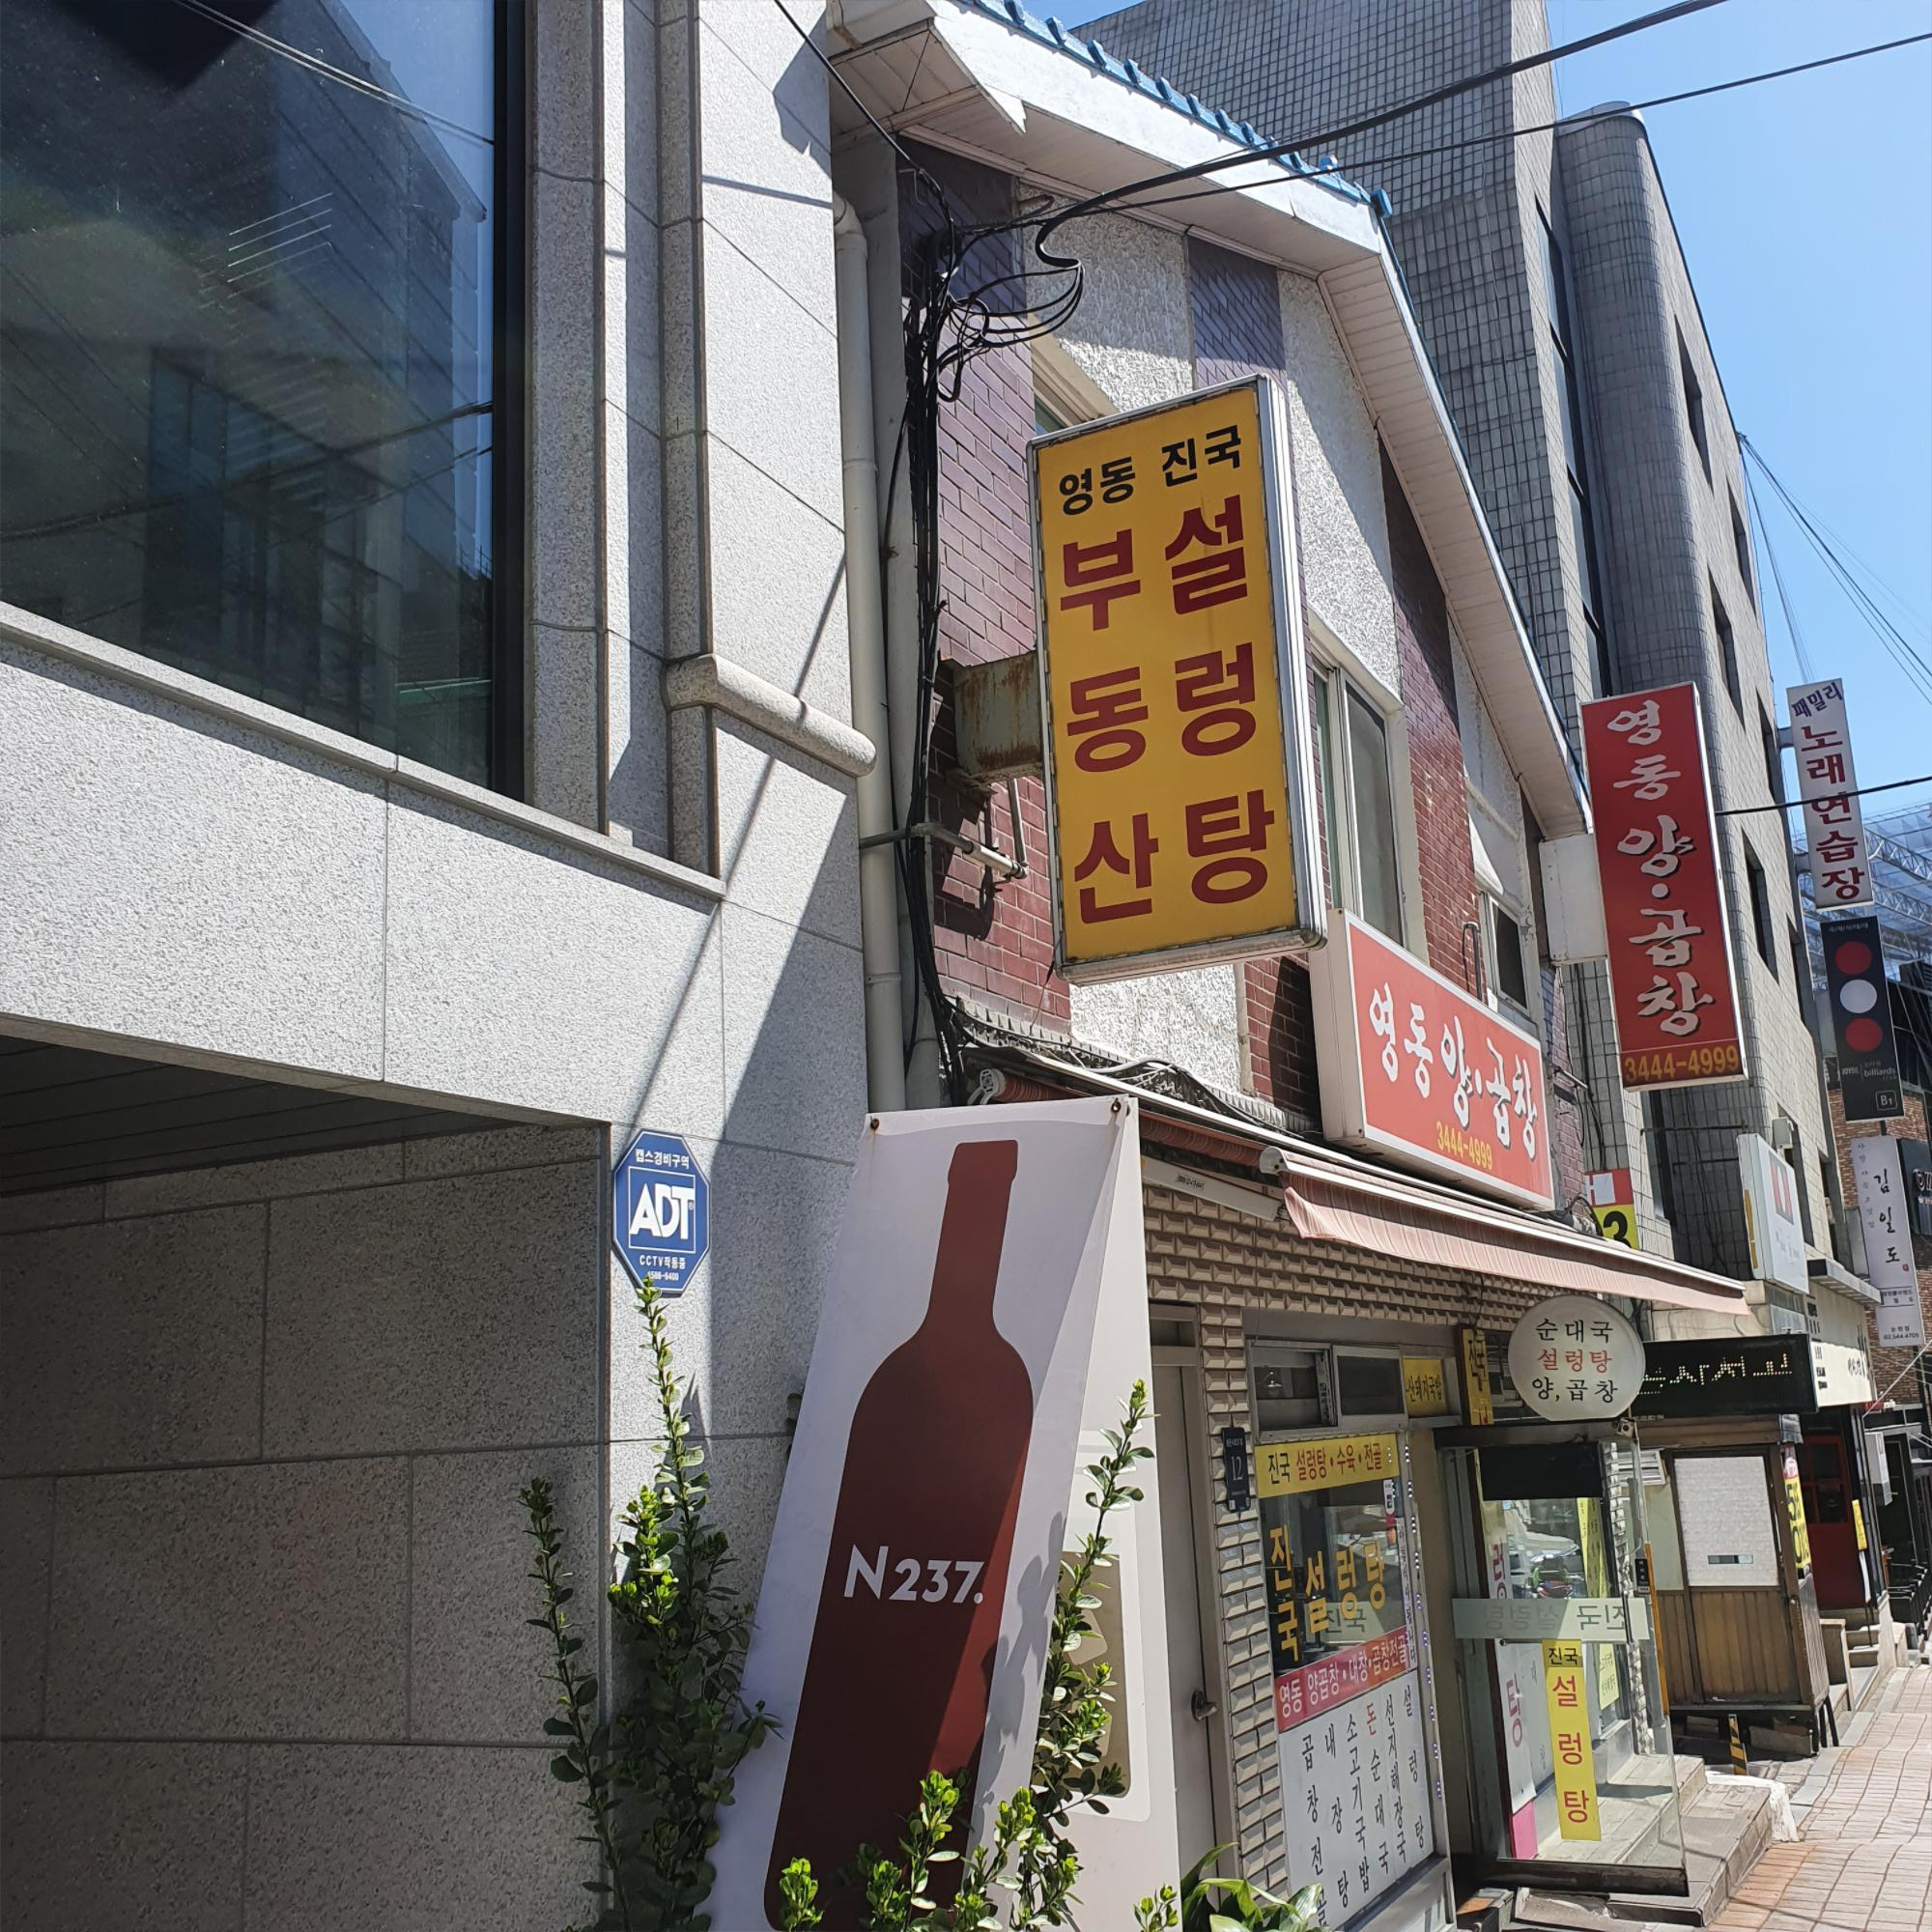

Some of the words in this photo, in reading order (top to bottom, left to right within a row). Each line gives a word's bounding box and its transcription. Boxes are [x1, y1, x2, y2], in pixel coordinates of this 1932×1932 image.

[1059, 456, 1136, 516] 영동
[1161, 425, 1242, 488] 진국
[1060, 528, 1159, 924] 부동산
[1164, 495, 1275, 905] 설렁탕
[1791, 681, 1843, 719] 패밀리
[1801, 725, 1865, 900] 노래연습장
[1624, 1044, 1740, 1083] 3444-4999
[1880, 1094, 1892, 1106] B1
[635, 1149, 690, 1169] 캡스경비구역
[1436, 1121, 1492, 1171] 3444-4999
[629, 1182, 695, 1240] ADT
[1873, 1168, 1901, 1264] 김일도
[639, 1254, 686, 1269] CCTV작동중
[1535, 1318, 1613, 1344] 순대국
[1537, 1348, 1612, 1374] 설렁탕
[1231, 1456, 1243, 1481] 12
[1267, 1452, 1291, 1485] 진국
[843, 1544, 983, 1605] N237.
[1269, 1524, 1299, 1662] 진국
[1305, 1540, 1386, 1634] 설렁탕
[1548, 1647, 1579, 1666] 진국
[1279, 1678, 1303, 1718] 영동
[1385, 1693, 1406, 1863] 선지해장국
[1404, 1685, 1424, 1850] 설렁탕
[1552, 1675, 1589, 1824] 설렁탕
[1324, 1722, 1350, 1909] 내장탕
[1347, 1714, 1370, 1893] 소고기국밥
